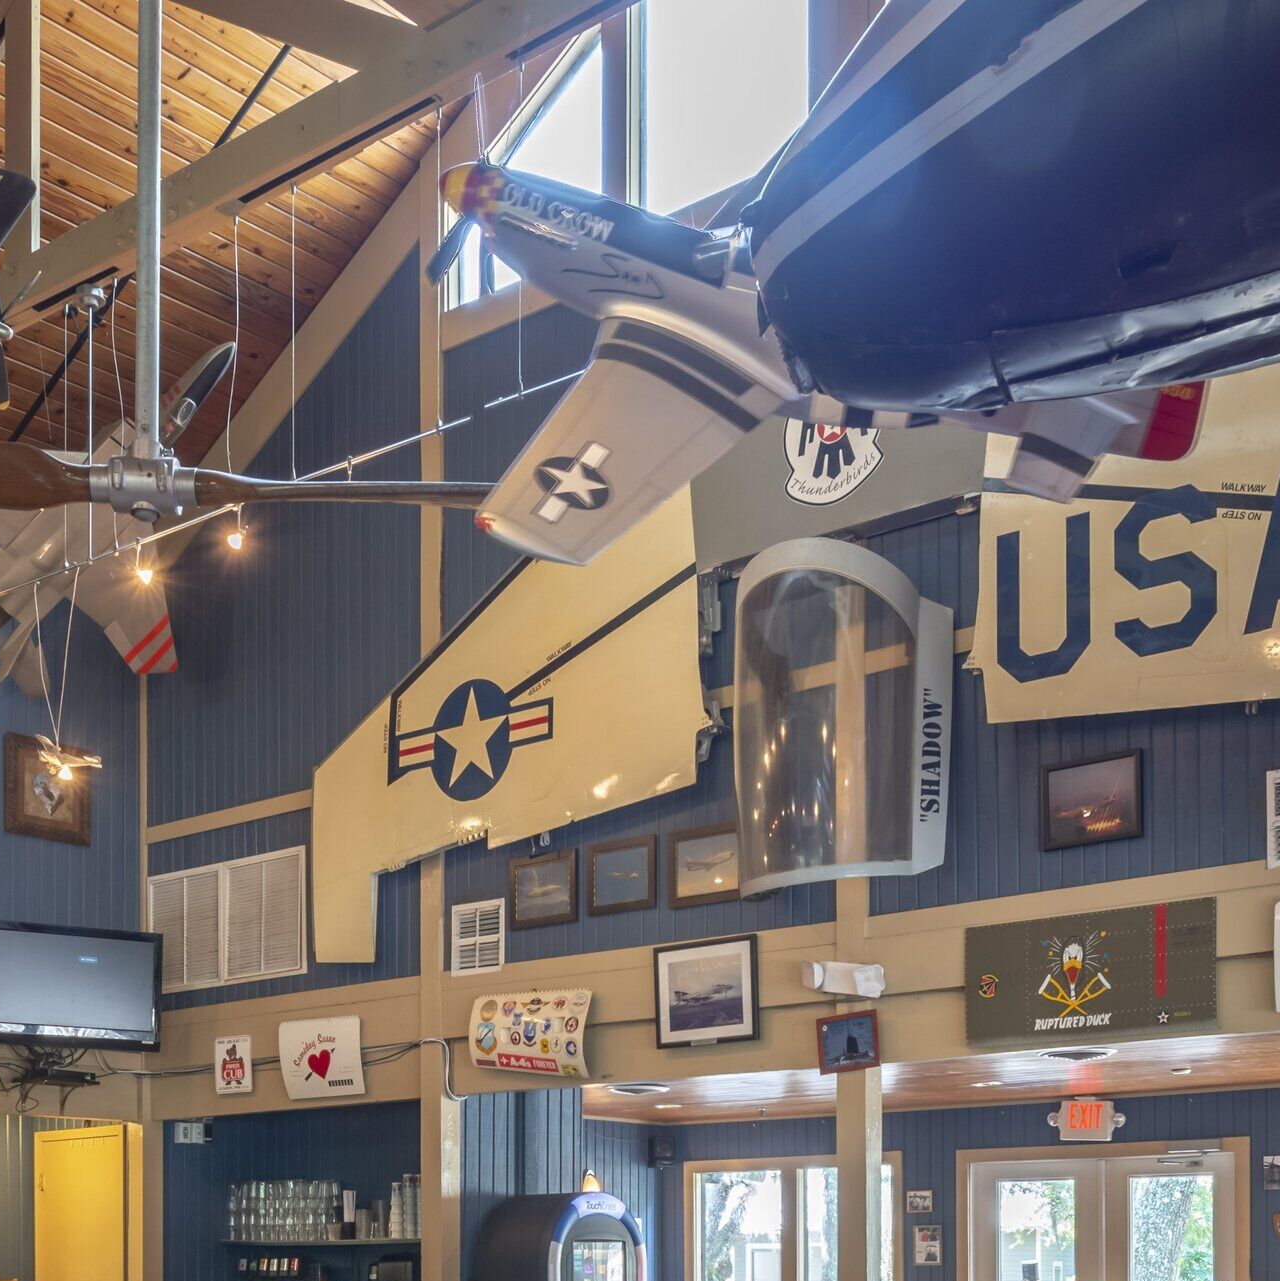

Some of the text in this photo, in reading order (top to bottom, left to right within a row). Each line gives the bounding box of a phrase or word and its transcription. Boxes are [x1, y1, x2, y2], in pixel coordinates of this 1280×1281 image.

[502, 183, 616, 242] OLD CROW
[790, 452, 876, 495] Thunderbirds
[1221, 482, 1267, 493] WALKWAY
[1221, 510, 1262, 521] NO STEP
[546, 641, 572, 662] WALKWAY
[919, 687, 943, 823] "SHADOW"
[1034, 1012, 1112, 1031] RUPTURED DUCK
[317, 1034, 336, 1044] Susan
[223, 1069, 243, 1079] CUB
[1069, 1103, 1103, 1129] EXIT
